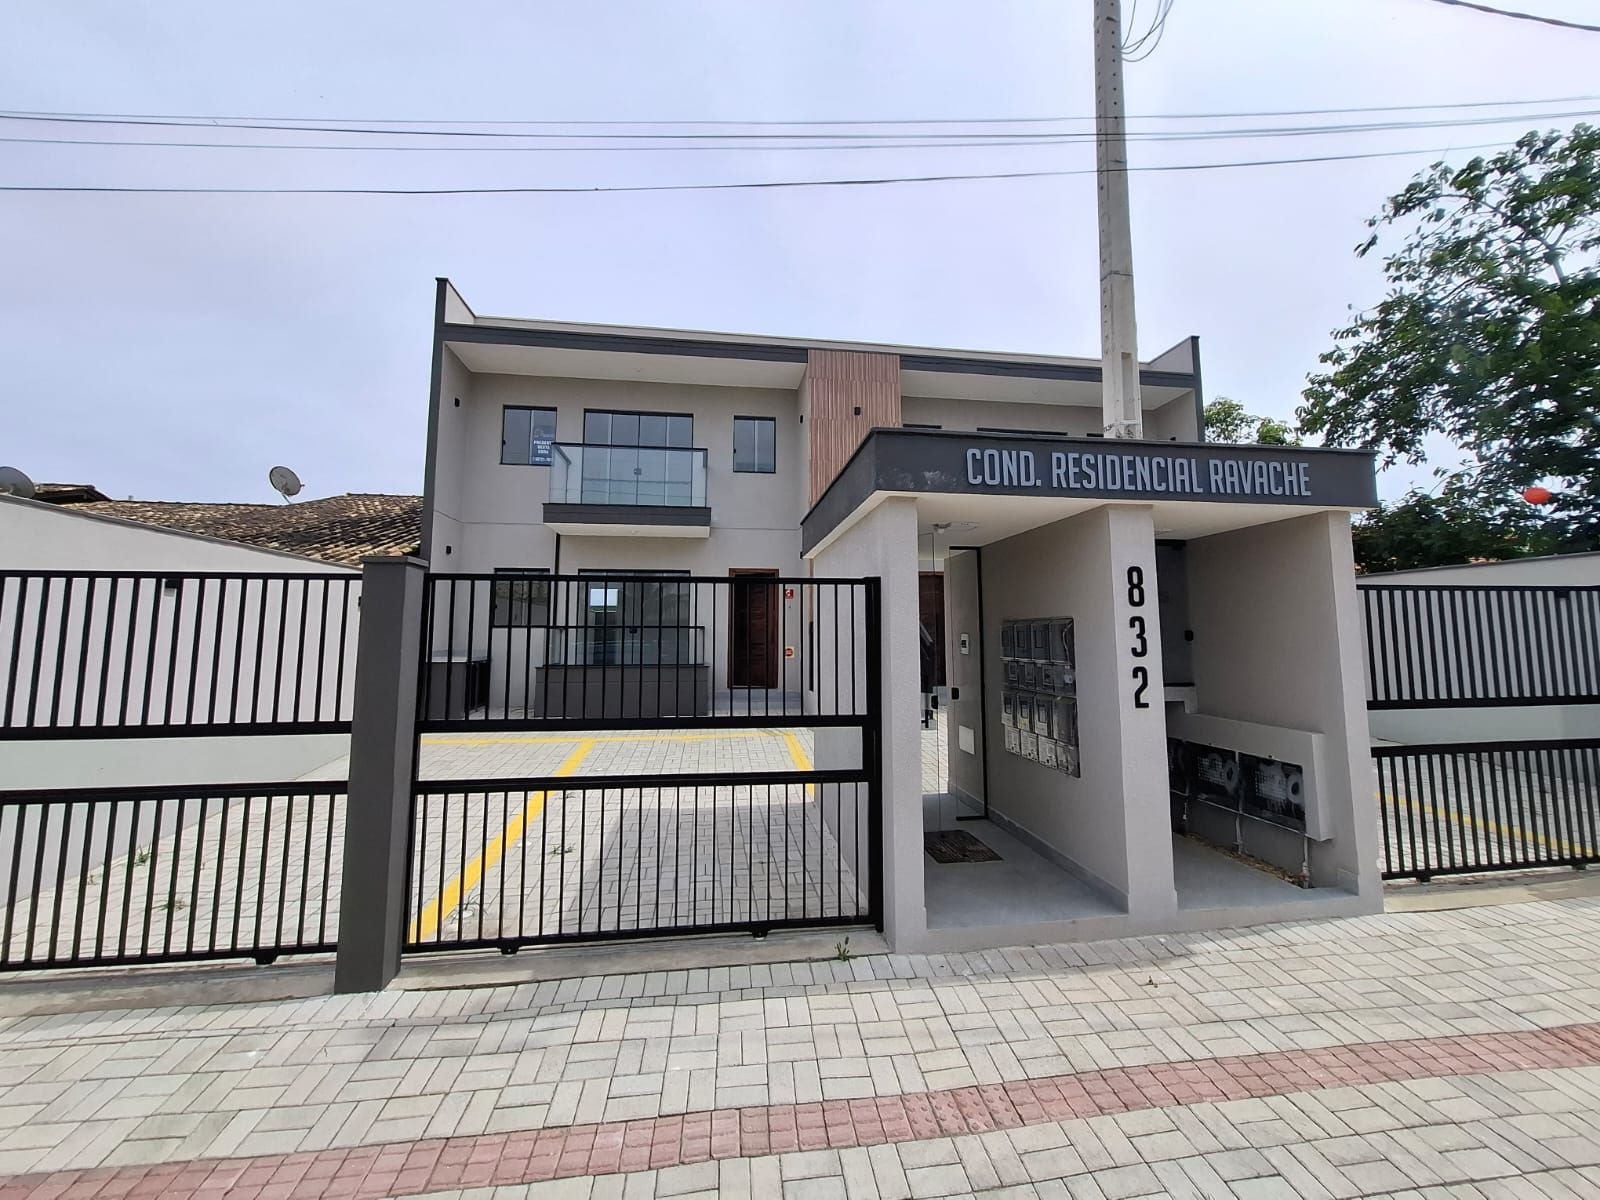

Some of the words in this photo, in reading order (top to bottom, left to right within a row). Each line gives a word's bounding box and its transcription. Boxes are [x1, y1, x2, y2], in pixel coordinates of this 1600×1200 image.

[967, 448, 1042, 487] COND.
[1051, 452, 1204, 494] RESIDENCIAL
[1208, 458, 1312, 497] RAVACHE
[1126, 565, 1150, 709] 832
